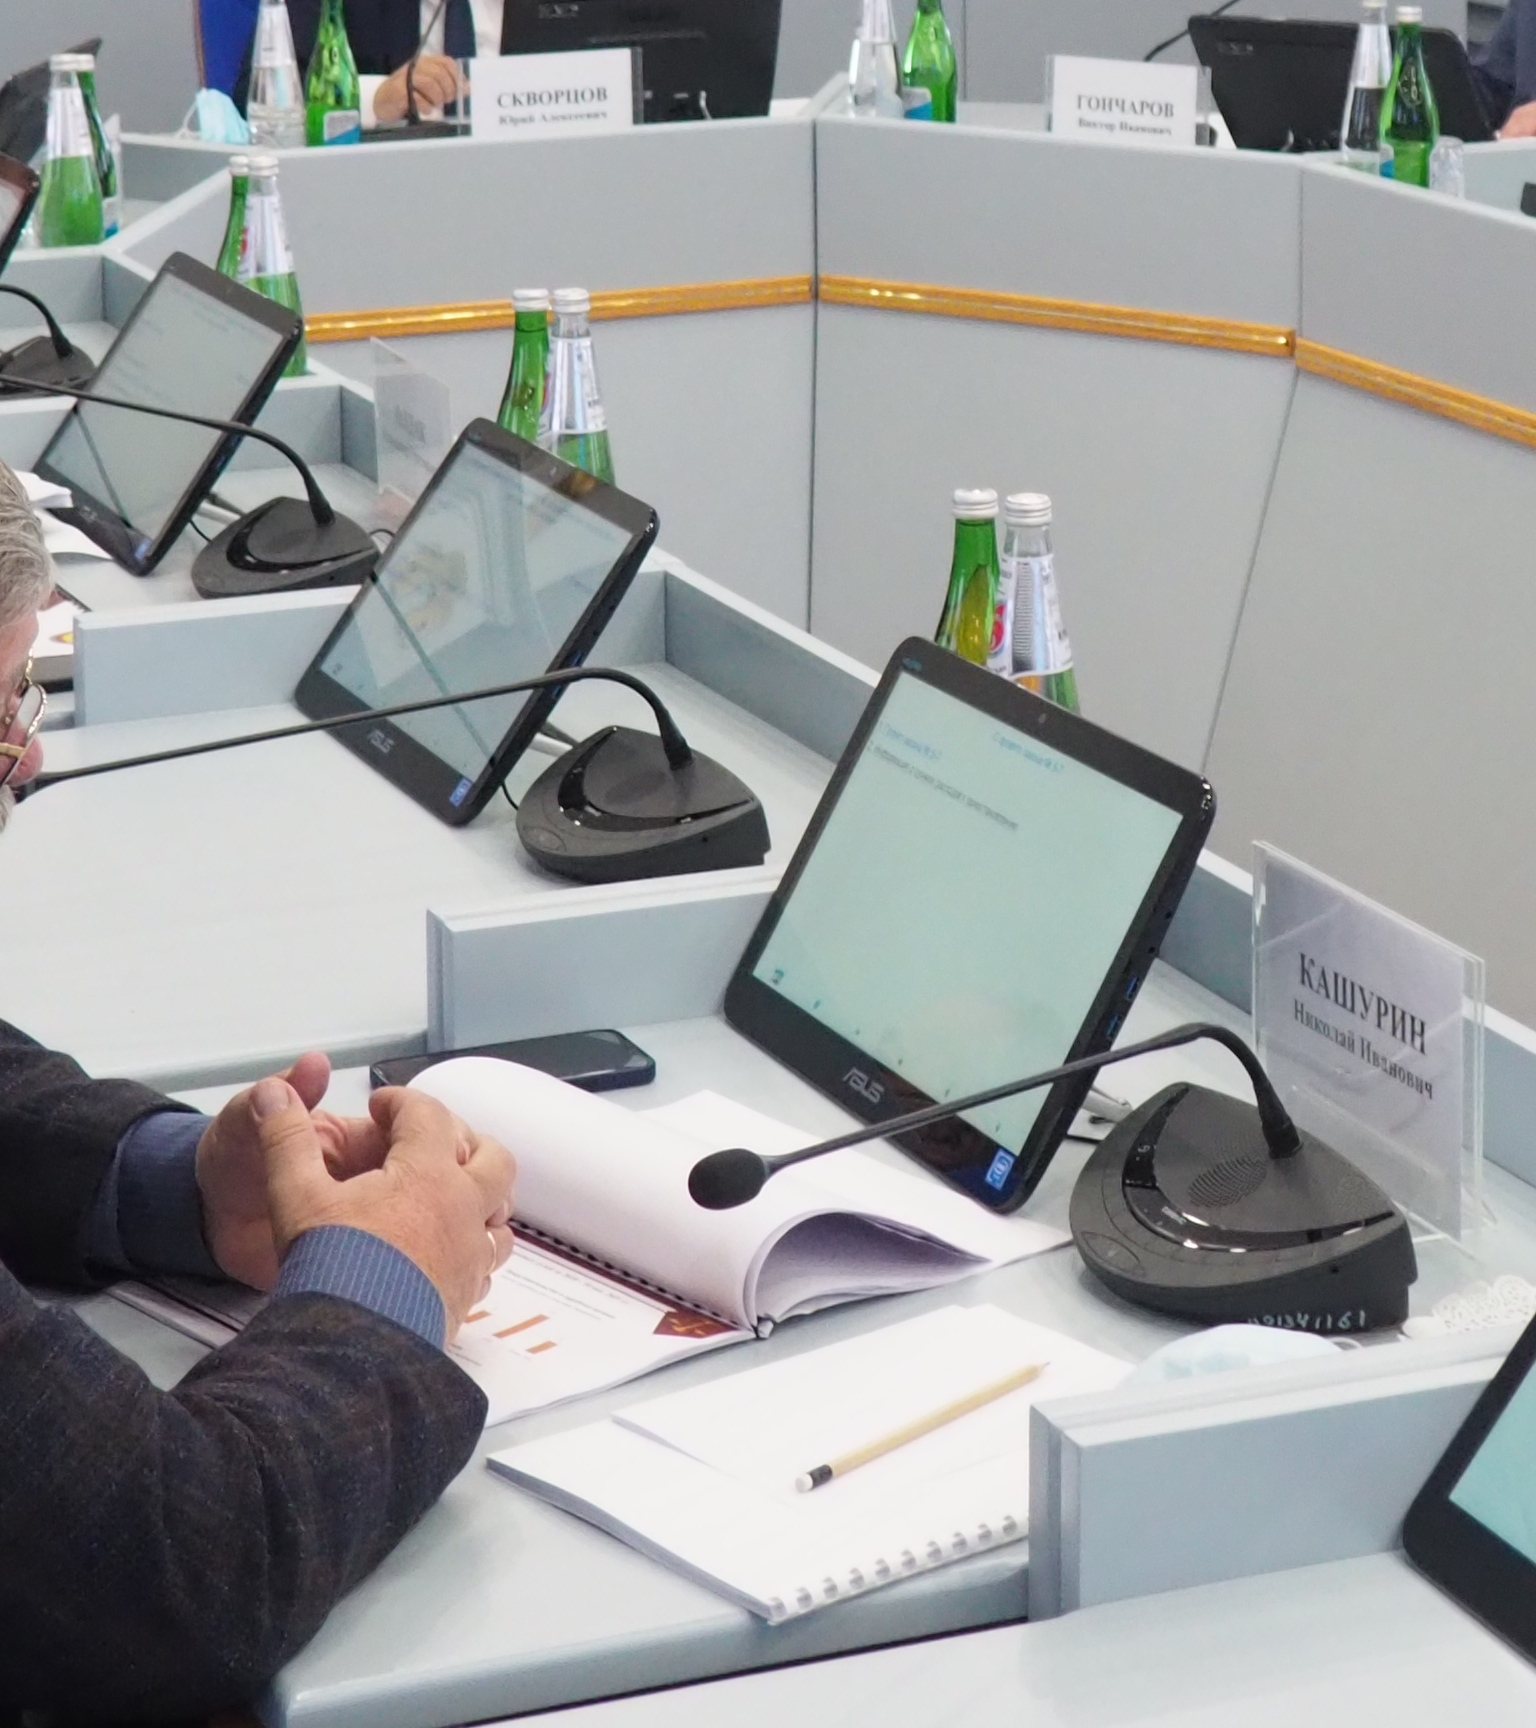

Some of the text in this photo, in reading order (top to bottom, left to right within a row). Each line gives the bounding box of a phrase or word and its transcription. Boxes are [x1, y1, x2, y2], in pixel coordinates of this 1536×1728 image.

[497, 87, 608, 108] СКВОРЦОВ
[1077, 94, 1174, 118] ГОНЧАРОВ
[499, 111, 608, 127] Юрий Алексеевич
[1078, 117, 1172, 136] Виктор Иванович
[1300, 952, 1426, 1055] КАШУРИН
[1294, 997, 1433, 1100] Николай Иванович
[842, 1066, 885, 1103] ASUS
